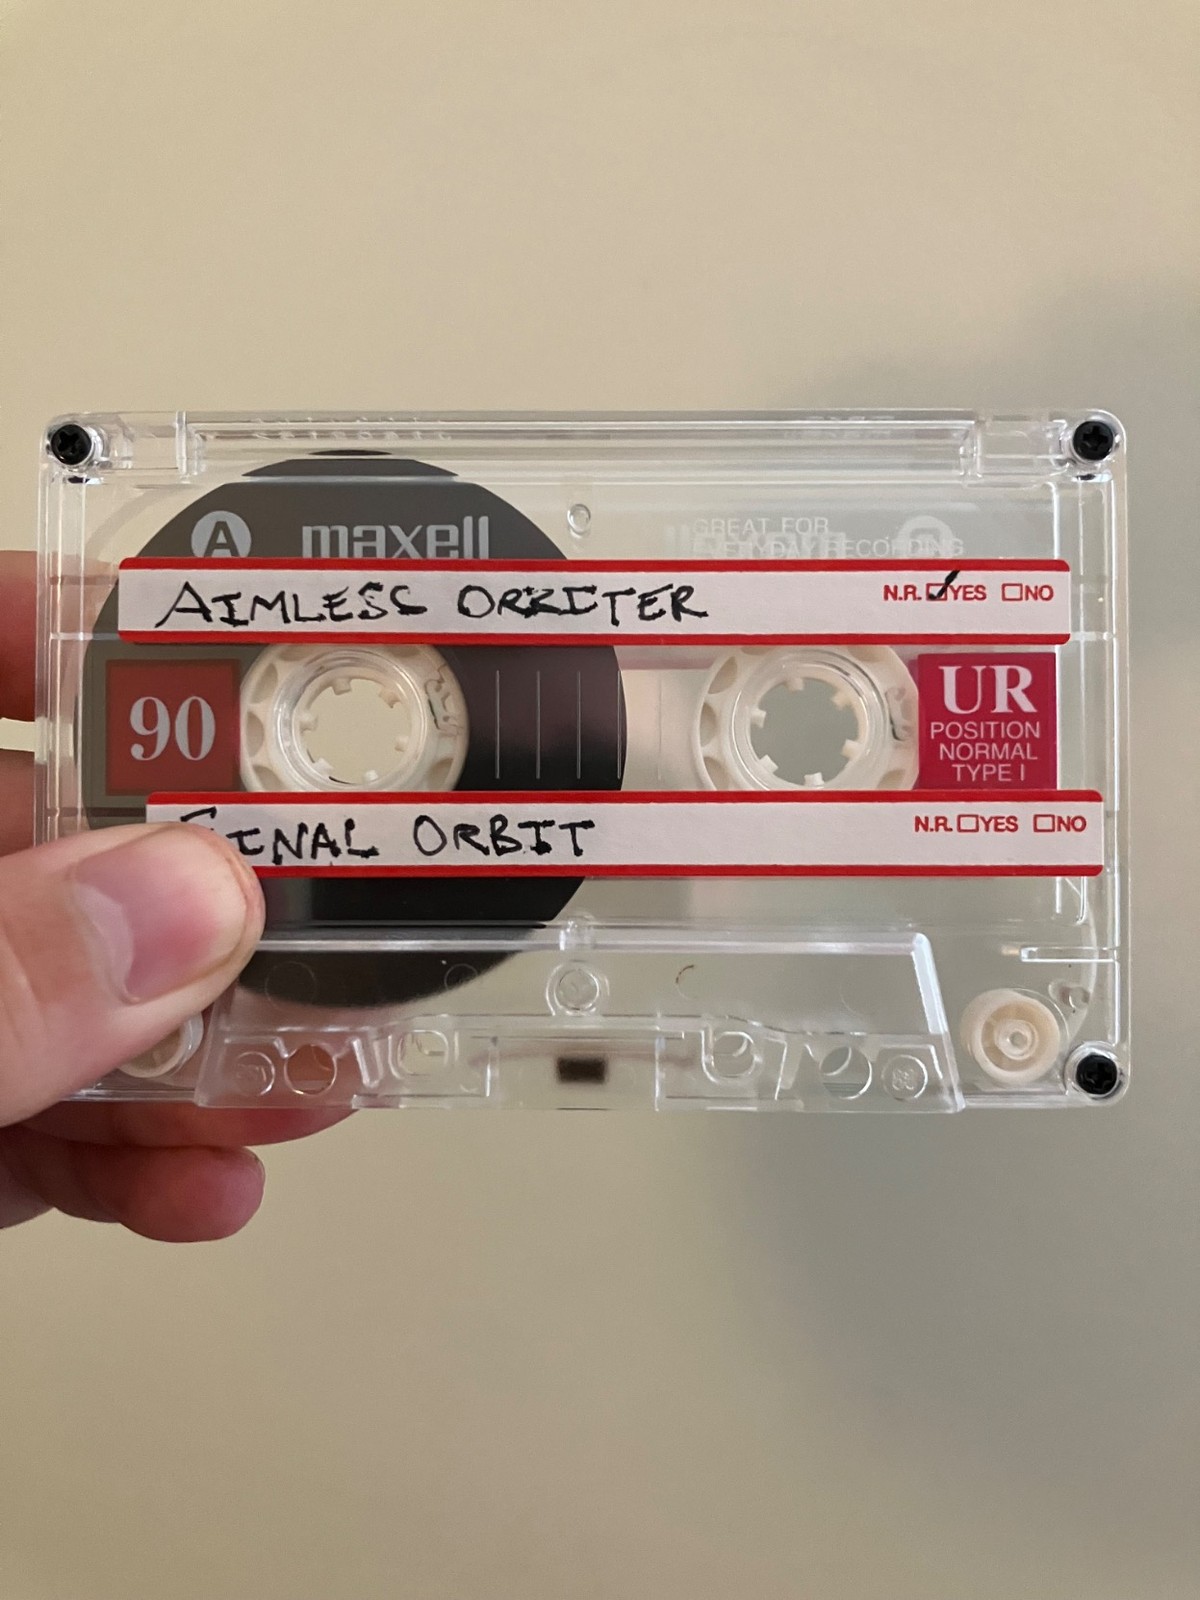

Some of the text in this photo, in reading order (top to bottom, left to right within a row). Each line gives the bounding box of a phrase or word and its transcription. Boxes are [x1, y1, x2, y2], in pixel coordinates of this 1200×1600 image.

[694, 516, 830, 536] GREAT FOR
[302, 516, 489, 559] maxell
[883, 584, 1055, 601] N.R. YES NO
[938, 664, 1038, 715] UR
[129, 696, 216, 761] 90
[930, 720, 1040, 740] POSITION
[939, 742, 1038, 761] NORMAL
[952, 763, 1012, 782] TYPE
[914, 815, 1088, 833] N.R. YES NO
[413, 813, 596, 858] ORBIT
